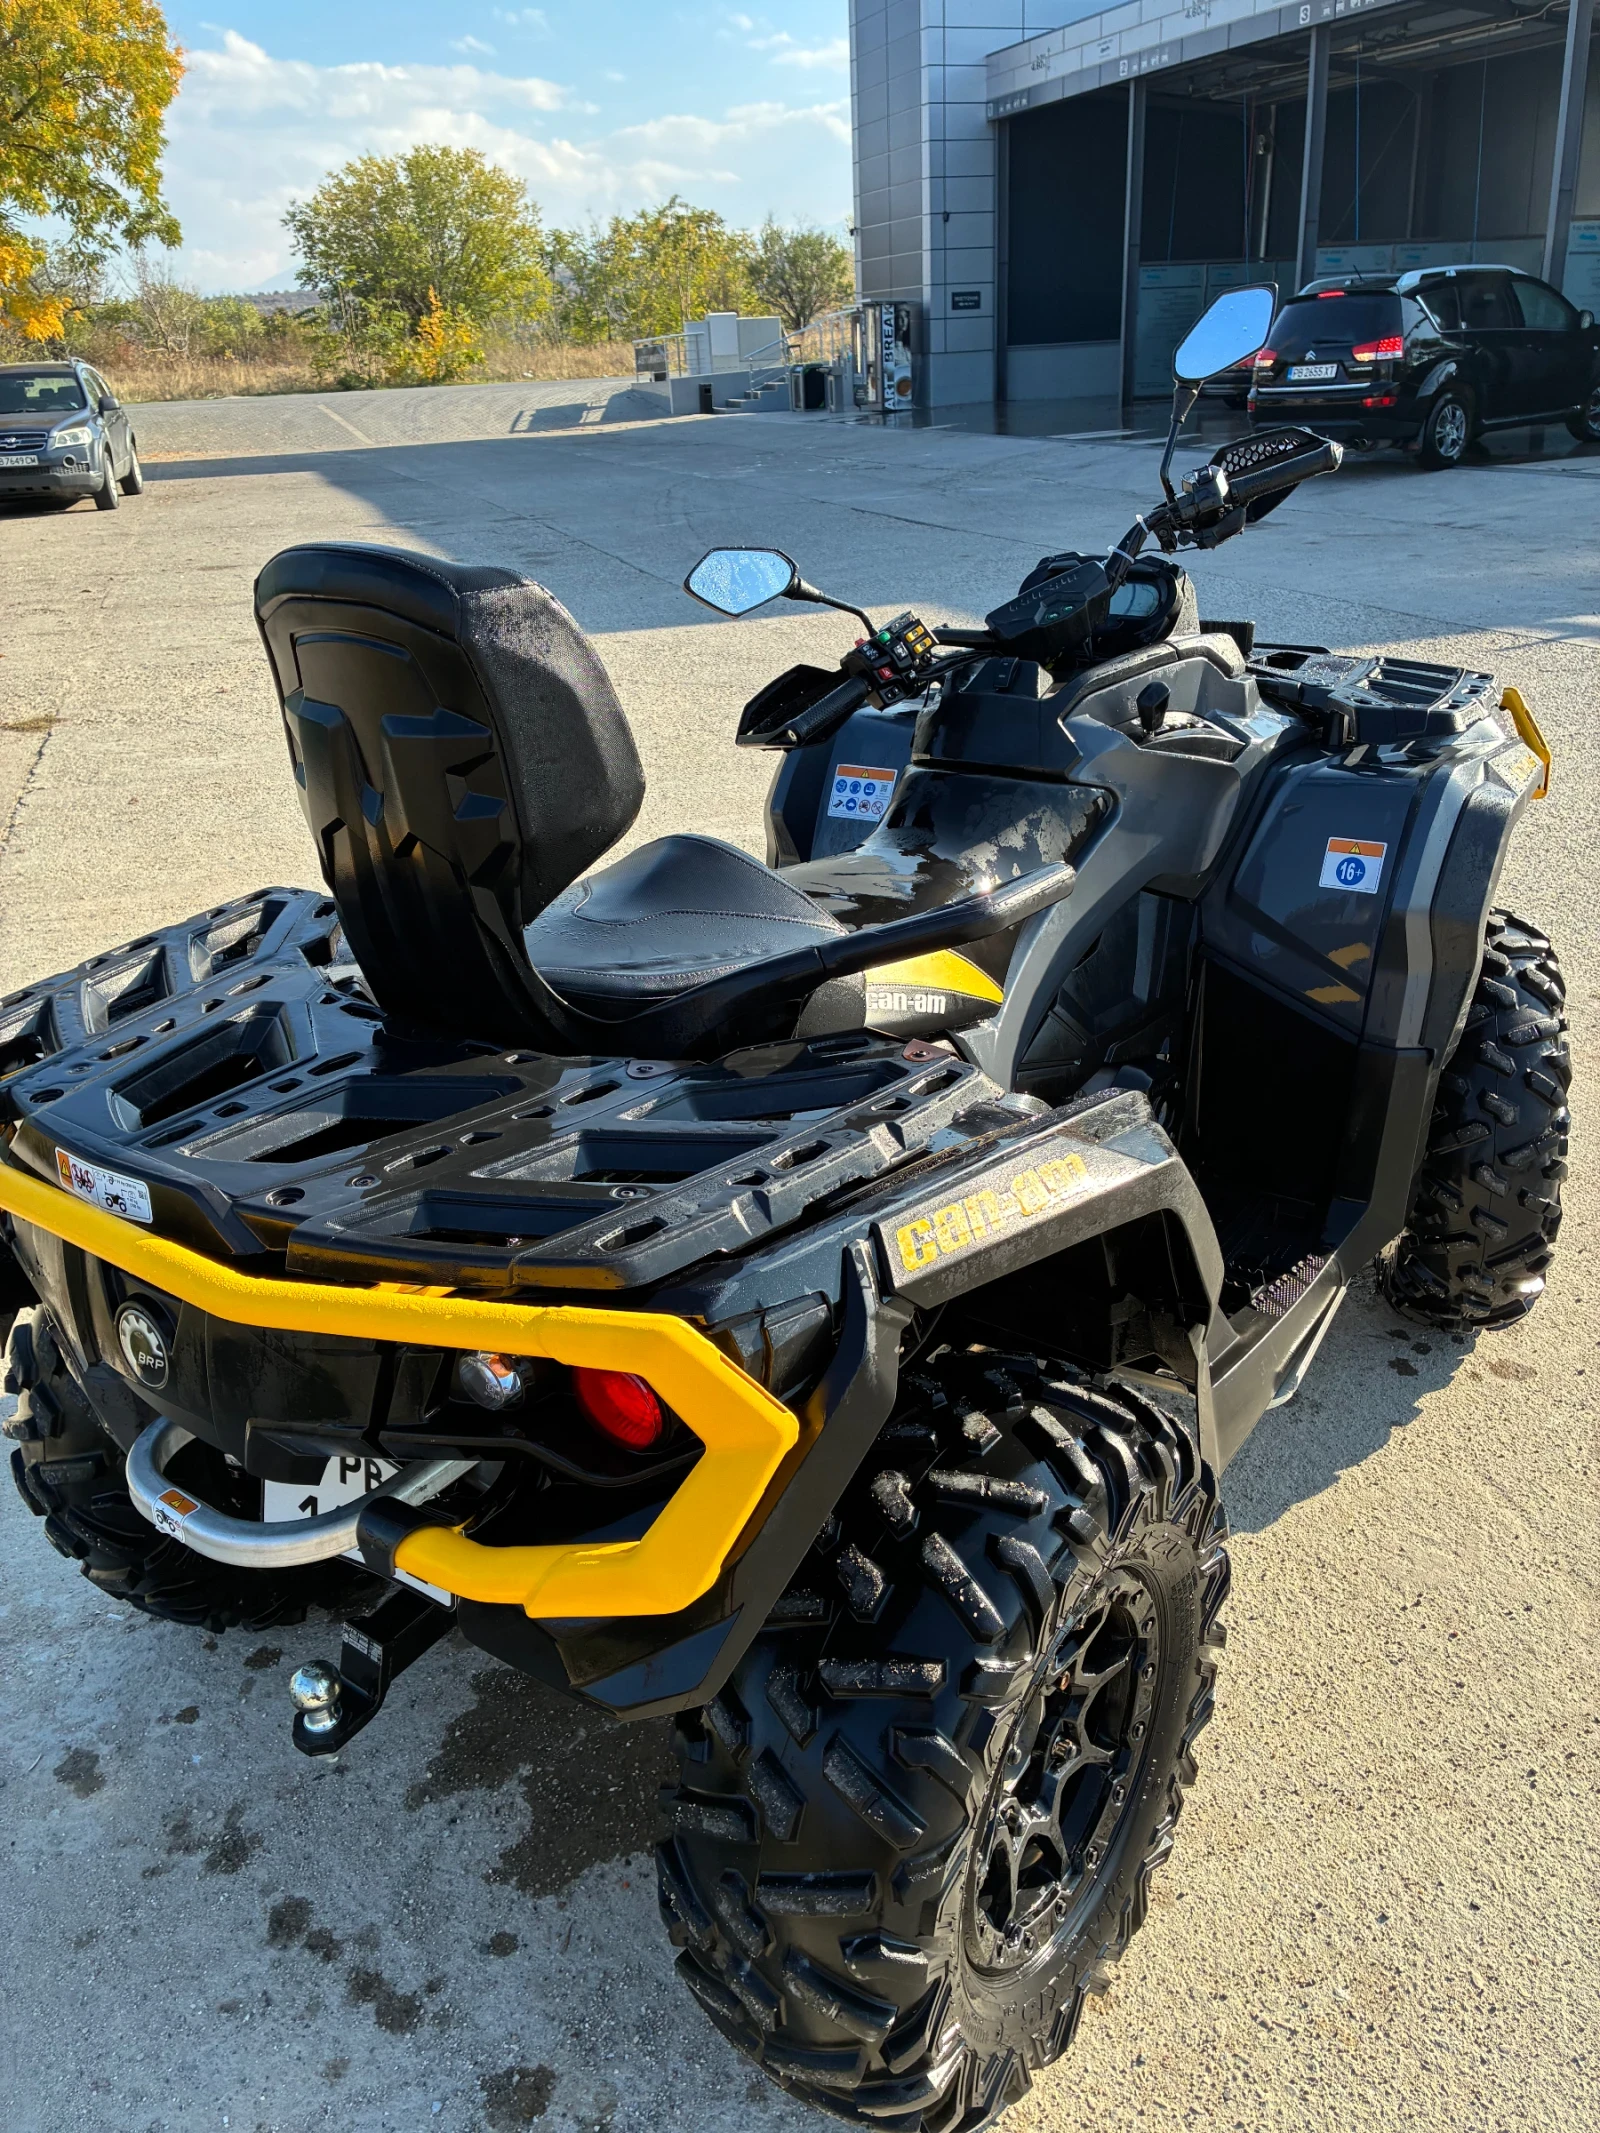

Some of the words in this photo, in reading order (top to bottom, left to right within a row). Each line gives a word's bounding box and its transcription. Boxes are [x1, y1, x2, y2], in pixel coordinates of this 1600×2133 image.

[1301, 7, 1309, 22] 3
[883, 304, 895, 363] BREAK
[1324, 365, 1335, 377] XT
[884, 373, 897, 410] ART
[1340, 862, 1364, 881] 16+
[866, 991, 946, 1014] can-am
[897, 1152, 1088, 1271] can-am
[138, 1352, 165, 1369] BRP
